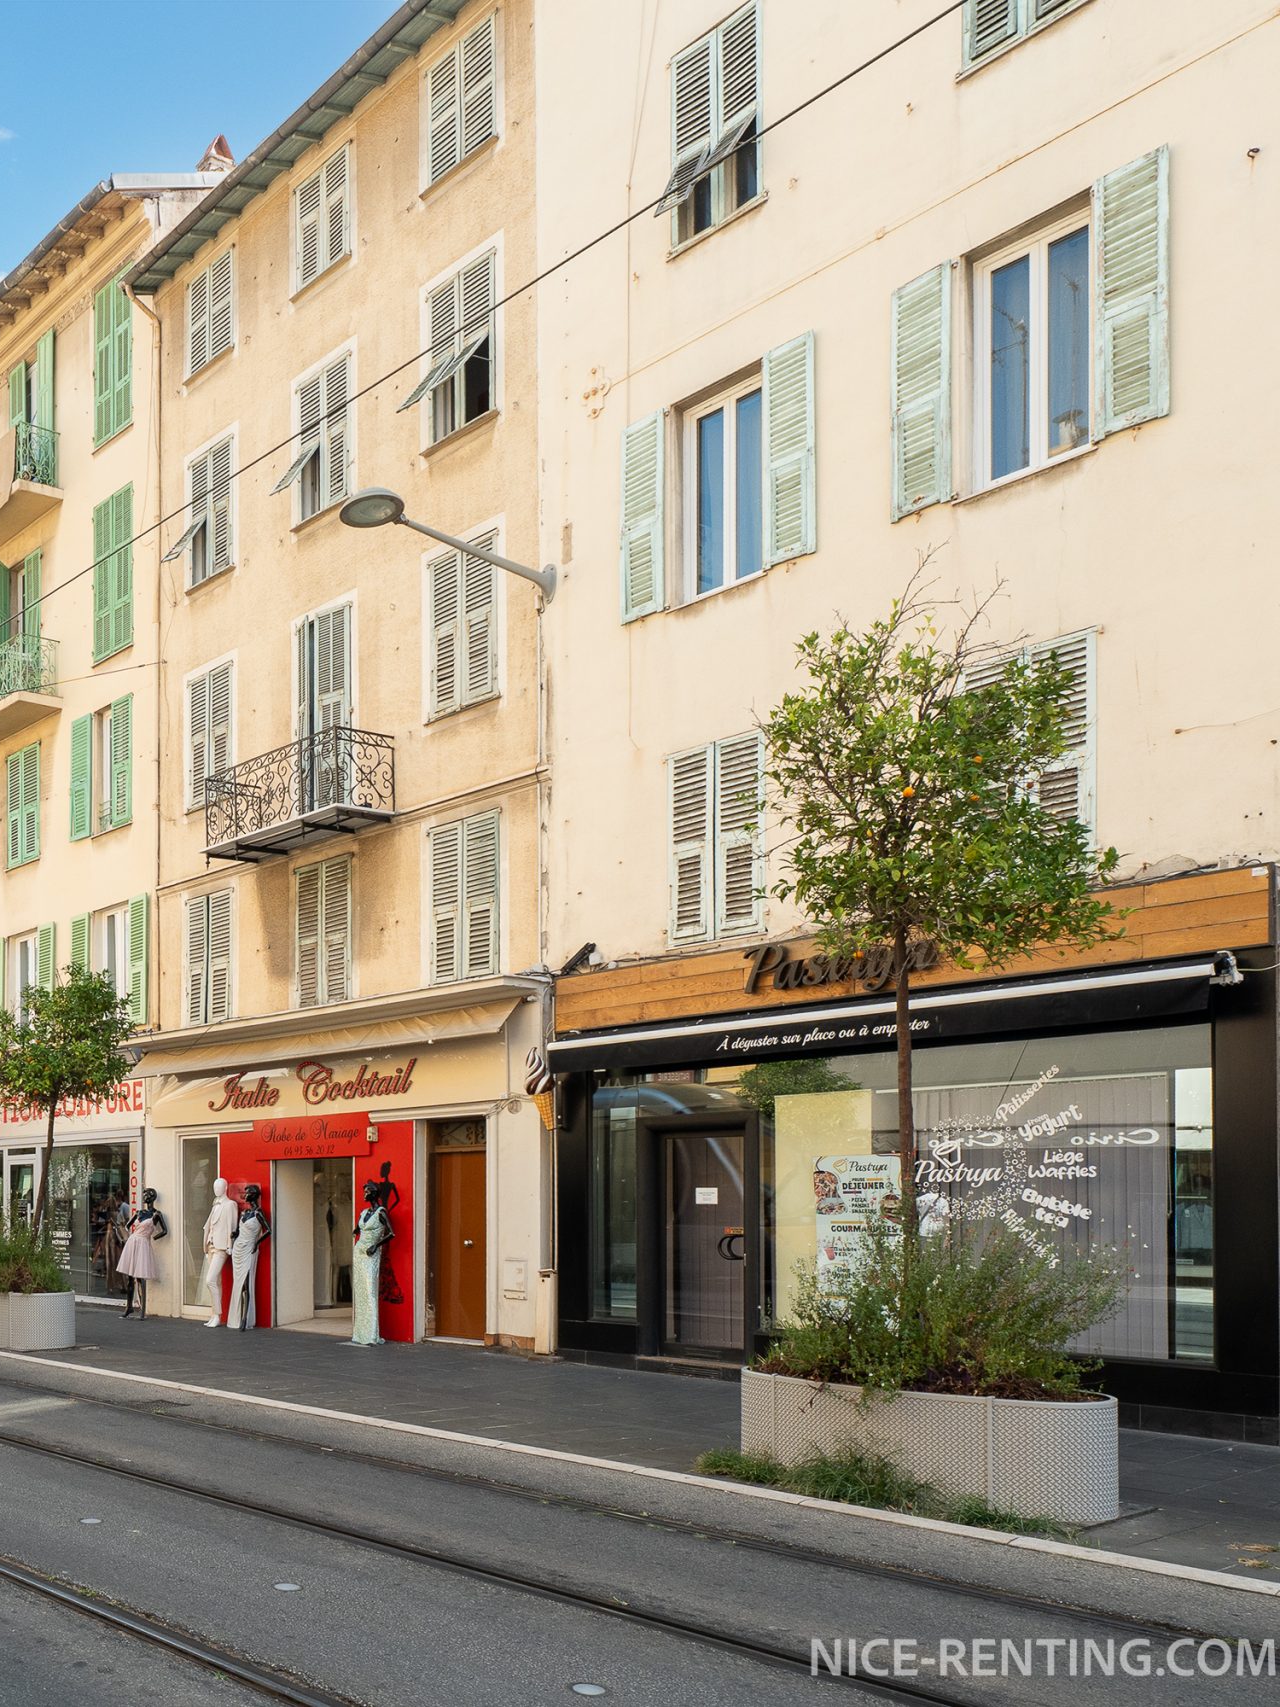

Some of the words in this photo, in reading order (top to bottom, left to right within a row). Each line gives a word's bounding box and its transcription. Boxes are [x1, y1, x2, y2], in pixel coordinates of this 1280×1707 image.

[743, 940, 938, 994] Pastrya
[732, 1034, 778, 1052] déguster
[781, 1032, 801, 1044] sur
[802, 1027, 835, 1046] place
[839, 1029, 855, 1038] ou
[859, 1024, 869, 1036] à
[872, 1018, 930, 1037] empter
[208, 1071, 280, 1112] Italie
[296, 1057, 418, 1105] Cocktail
[261, 1122, 293, 1143] Robe
[295, 1129, 306, 1140] de
[310, 1119, 360, 1144] Mariage
[1043, 1150, 1084, 1166] Liège
[842, 1181, 884, 1190] DÉJEUNER
[914, 1160, 1004, 1188] Pastrya
[1028, 1165, 1097, 1180] Waffles
[1021, 1188, 1093, 1220] Bubble
[1034, 1207, 1070, 1228] tea
